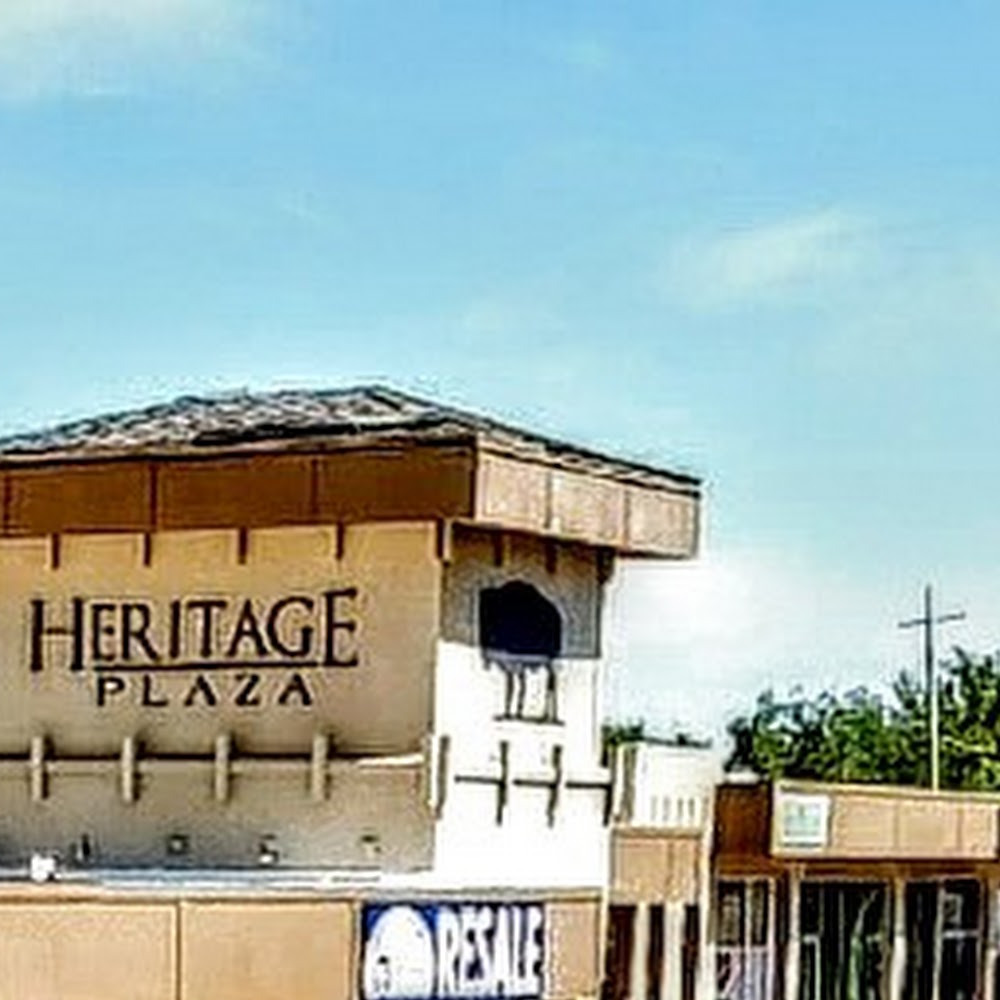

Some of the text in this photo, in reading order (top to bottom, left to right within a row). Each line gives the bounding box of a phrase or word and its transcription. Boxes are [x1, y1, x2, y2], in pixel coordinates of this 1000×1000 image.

[30, 588, 358, 672] HERITAGE
[97, 673, 313, 706] PLAZA
[436, 905, 543, 997] RESALE
